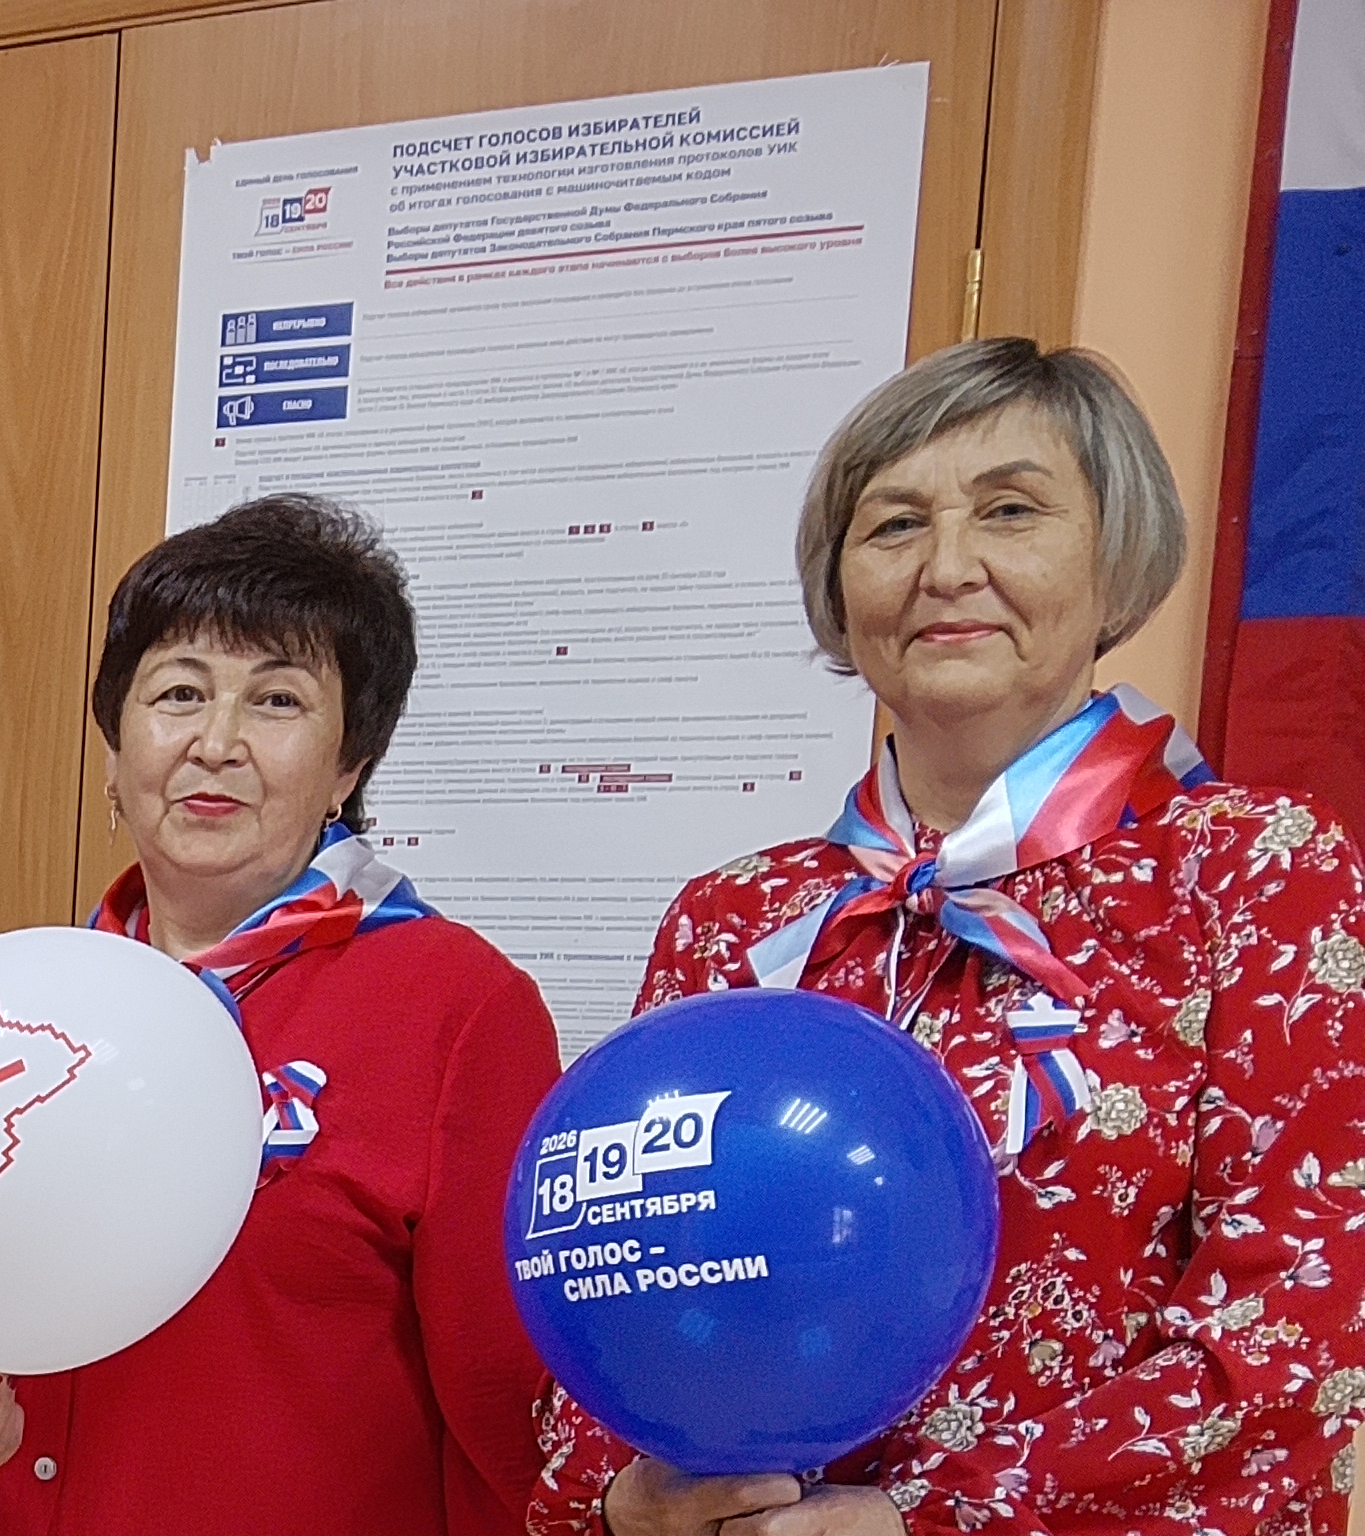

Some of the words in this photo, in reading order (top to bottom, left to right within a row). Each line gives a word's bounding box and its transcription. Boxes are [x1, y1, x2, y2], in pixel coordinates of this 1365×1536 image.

[393, 136, 474, 158] ПОДСЧЕТ
[479, 126, 562, 148] ГОЛОСОВ
[568, 106, 701, 138] ИЗБИРАТЕЛЕЙ
[393, 150, 510, 179] УЧАСТКОВОЙ
[516, 131, 674, 166] ИЗБИРАТЕЛЬНОЙ
[679, 117, 800, 147] КОМИССИЕЙ
[389, 199, 406, 213] об
[408, 198, 453, 211] итогах
[456, 187, 543, 206] голосования
[546, 185, 554, 195] с
[686, 167, 732, 184] кодом
[391, 186, 398, 196] с
[401, 176, 493, 198] применением
[496, 167, 574, 184] технологии
[578, 156, 675, 176] изготовления
[678, 147, 763, 166] протоколов
[767, 141, 798, 156] УИК
[264, 214, 279, 228] 18
[284, 203, 301, 219] 19
[305, 192, 326, 209] 20
[538, 1174, 574, 1216] 18
[583, 1142, 628, 1184] 19
[641, 1112, 704, 1154] 20
[539, 1130, 577, 1155] 2026
[587, 1190, 716, 1225] СЕНТЯБРЯ
[515, 1249, 554, 1281] ТВОЙ
[558, 1239, 642, 1272] ГОЛОС
[563, 1271, 632, 1301] СИЛА
[636, 1255, 768, 1292] РОССИИ
